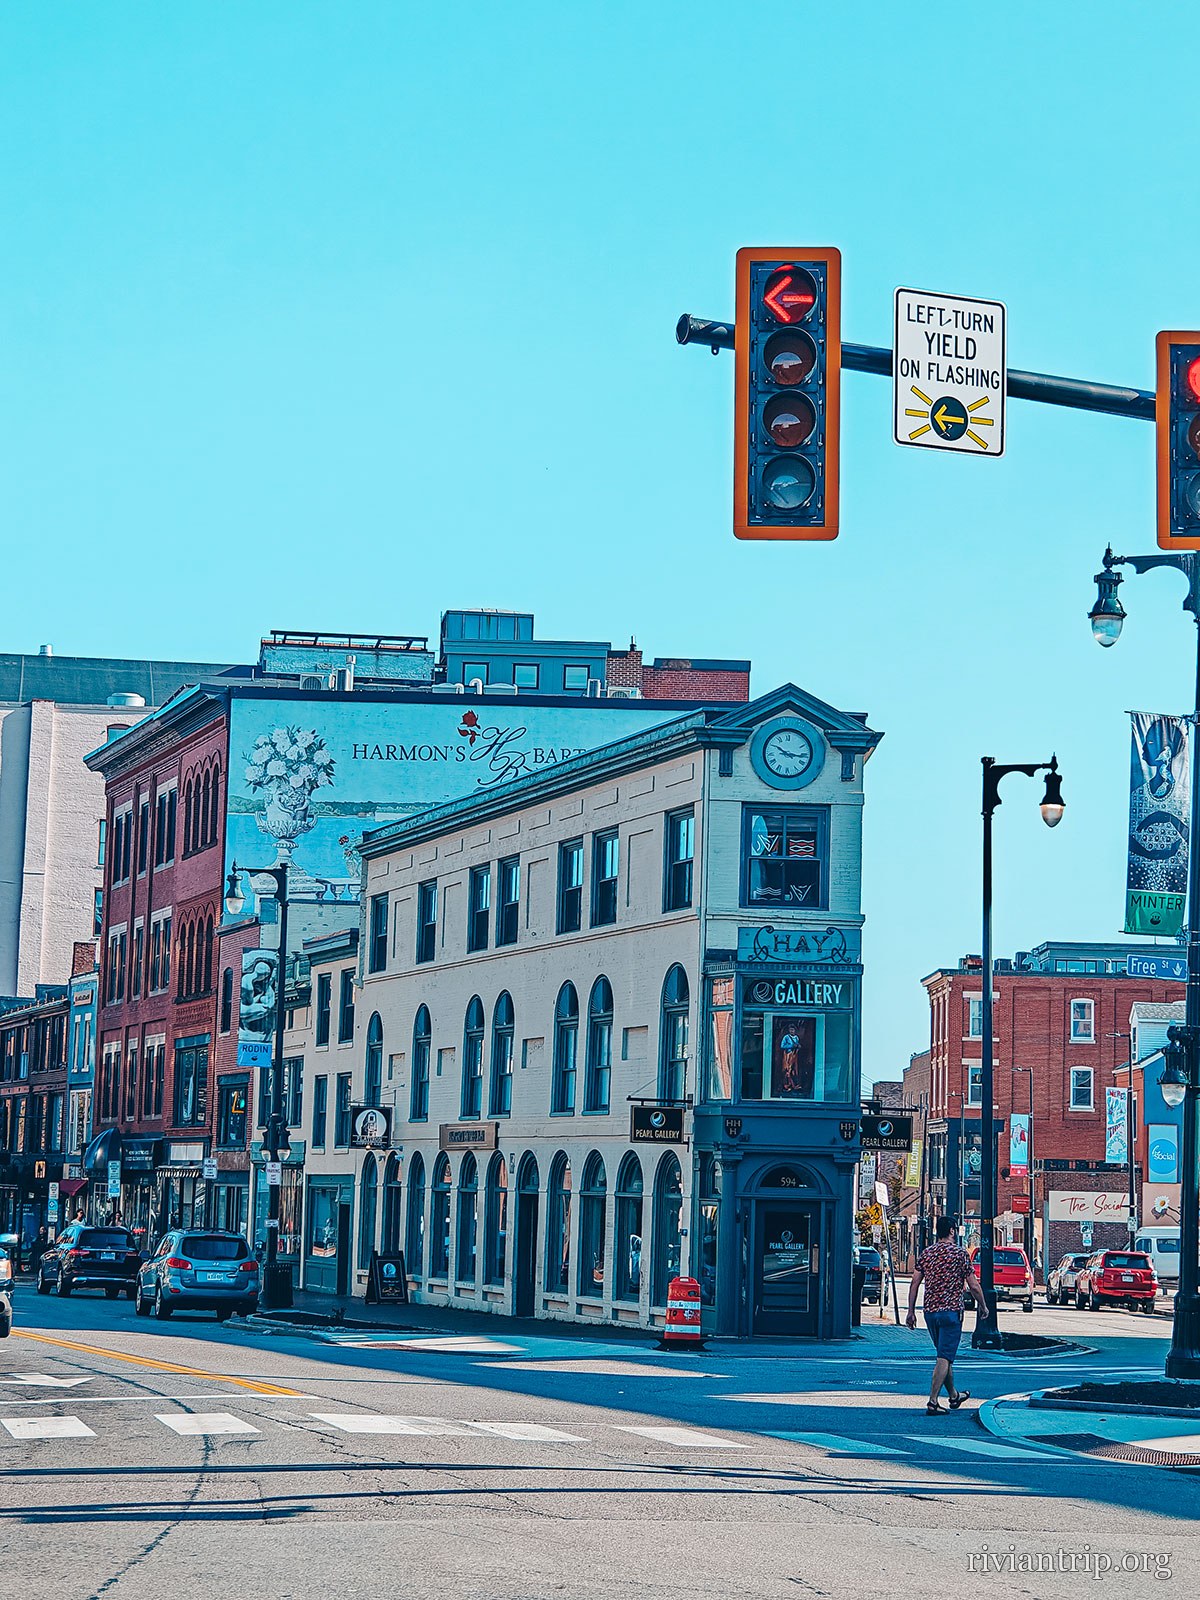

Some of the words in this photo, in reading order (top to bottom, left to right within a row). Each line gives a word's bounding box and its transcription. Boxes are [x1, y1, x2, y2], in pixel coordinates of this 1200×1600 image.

[907, 303, 946, 327] LEFT
[952, 309, 994, 334] TURN
[924, 331, 977, 360] YIELD
[900, 358, 920, 379] ON
[928, 362, 1000, 390] FLASHING
[352, 743, 466, 763] HARMON'S
[1130, 894, 1183, 911] MINTER
[773, 934, 830, 953] HAY
[1131, 957, 1157, 975] Free
[1161, 960, 1169, 969] St
[774, 983, 842, 1004] GALLERY
[242, 1044, 269, 1053] RODIN
[635, 1129, 654, 1139] PEARL
[654, 1130, 680, 1139] GALLERY
[862, 1137, 881, 1147] PEARL
[882, 1138, 909, 1148] GALLERY
[909, 1141, 920, 1176] WELCOME
[780, 1176, 797, 1187] 594
[1060, 1197, 1090, 1215] The
[1094, 1194, 1127, 1216] Social
[769, 1242, 784, 1250] PEARL
[784, 1242, 805, 1250] GALLERY
